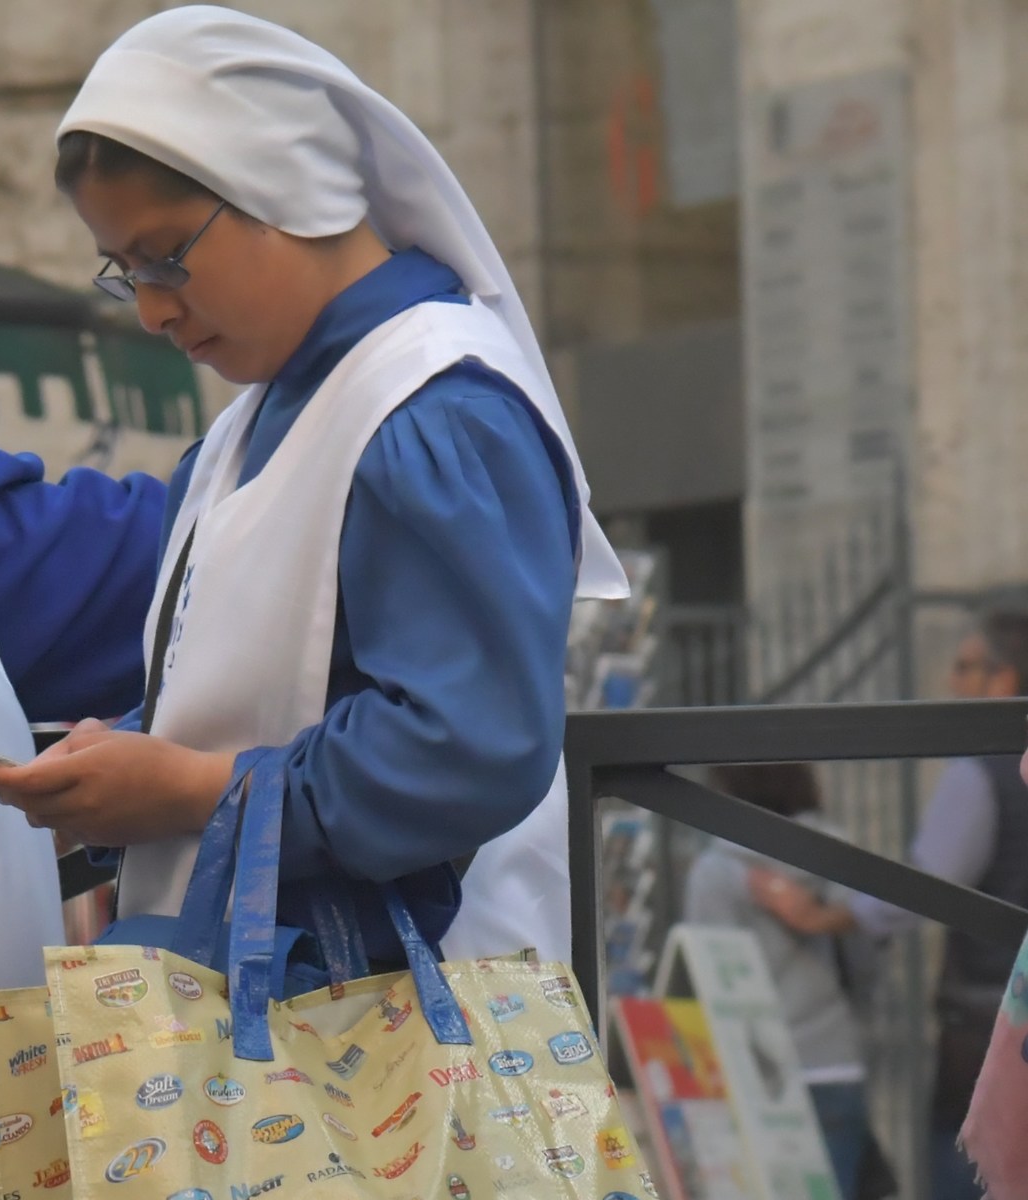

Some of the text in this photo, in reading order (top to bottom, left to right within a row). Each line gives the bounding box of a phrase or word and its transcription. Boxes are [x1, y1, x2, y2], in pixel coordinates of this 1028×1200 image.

[555, 1040, 587, 1059] Land
[496, 1054, 525, 1068] Blues
[145, 1075, 173, 1094] Soft
[144, 1092, 178, 1107] Dream
